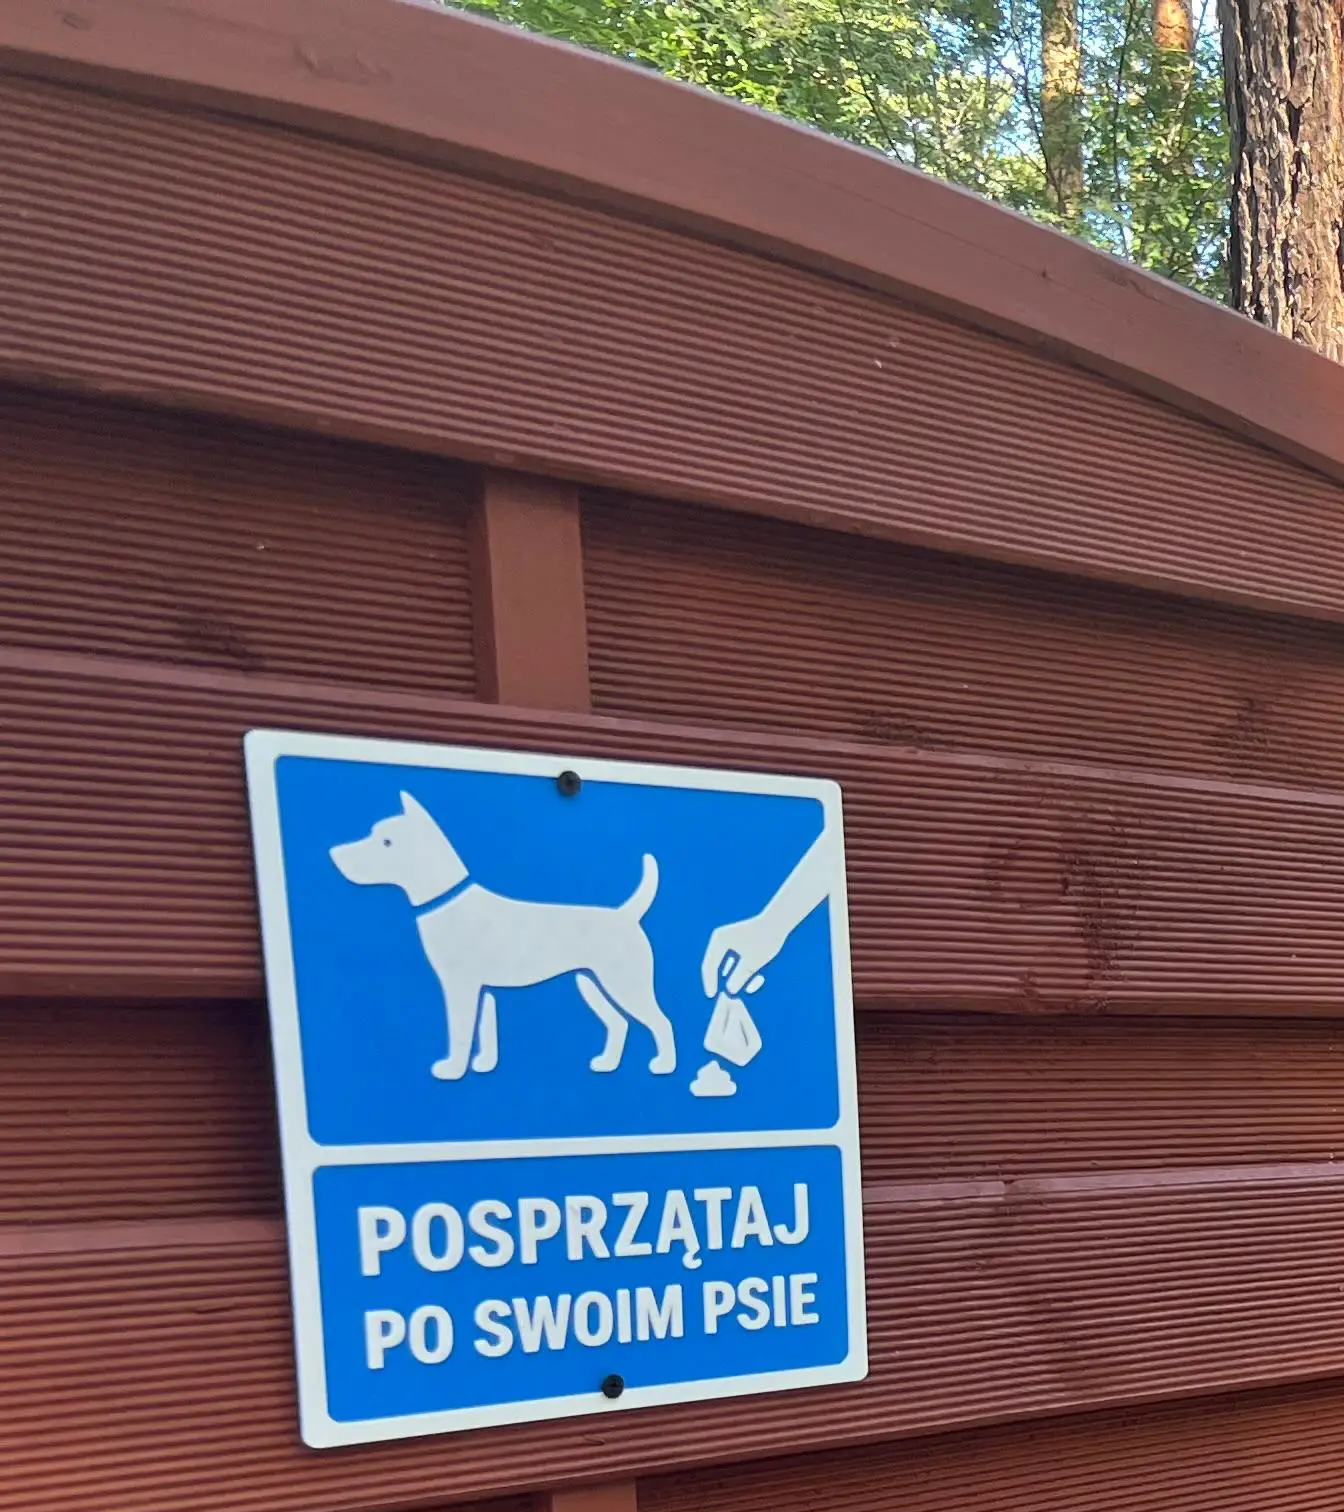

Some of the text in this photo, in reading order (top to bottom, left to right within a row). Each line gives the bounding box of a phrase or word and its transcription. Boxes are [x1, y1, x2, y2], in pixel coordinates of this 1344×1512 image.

[357, 1183, 810, 1276] POSPRZĄTAJ
[364, 1272, 820, 1369] PO SWOIM PSIE
